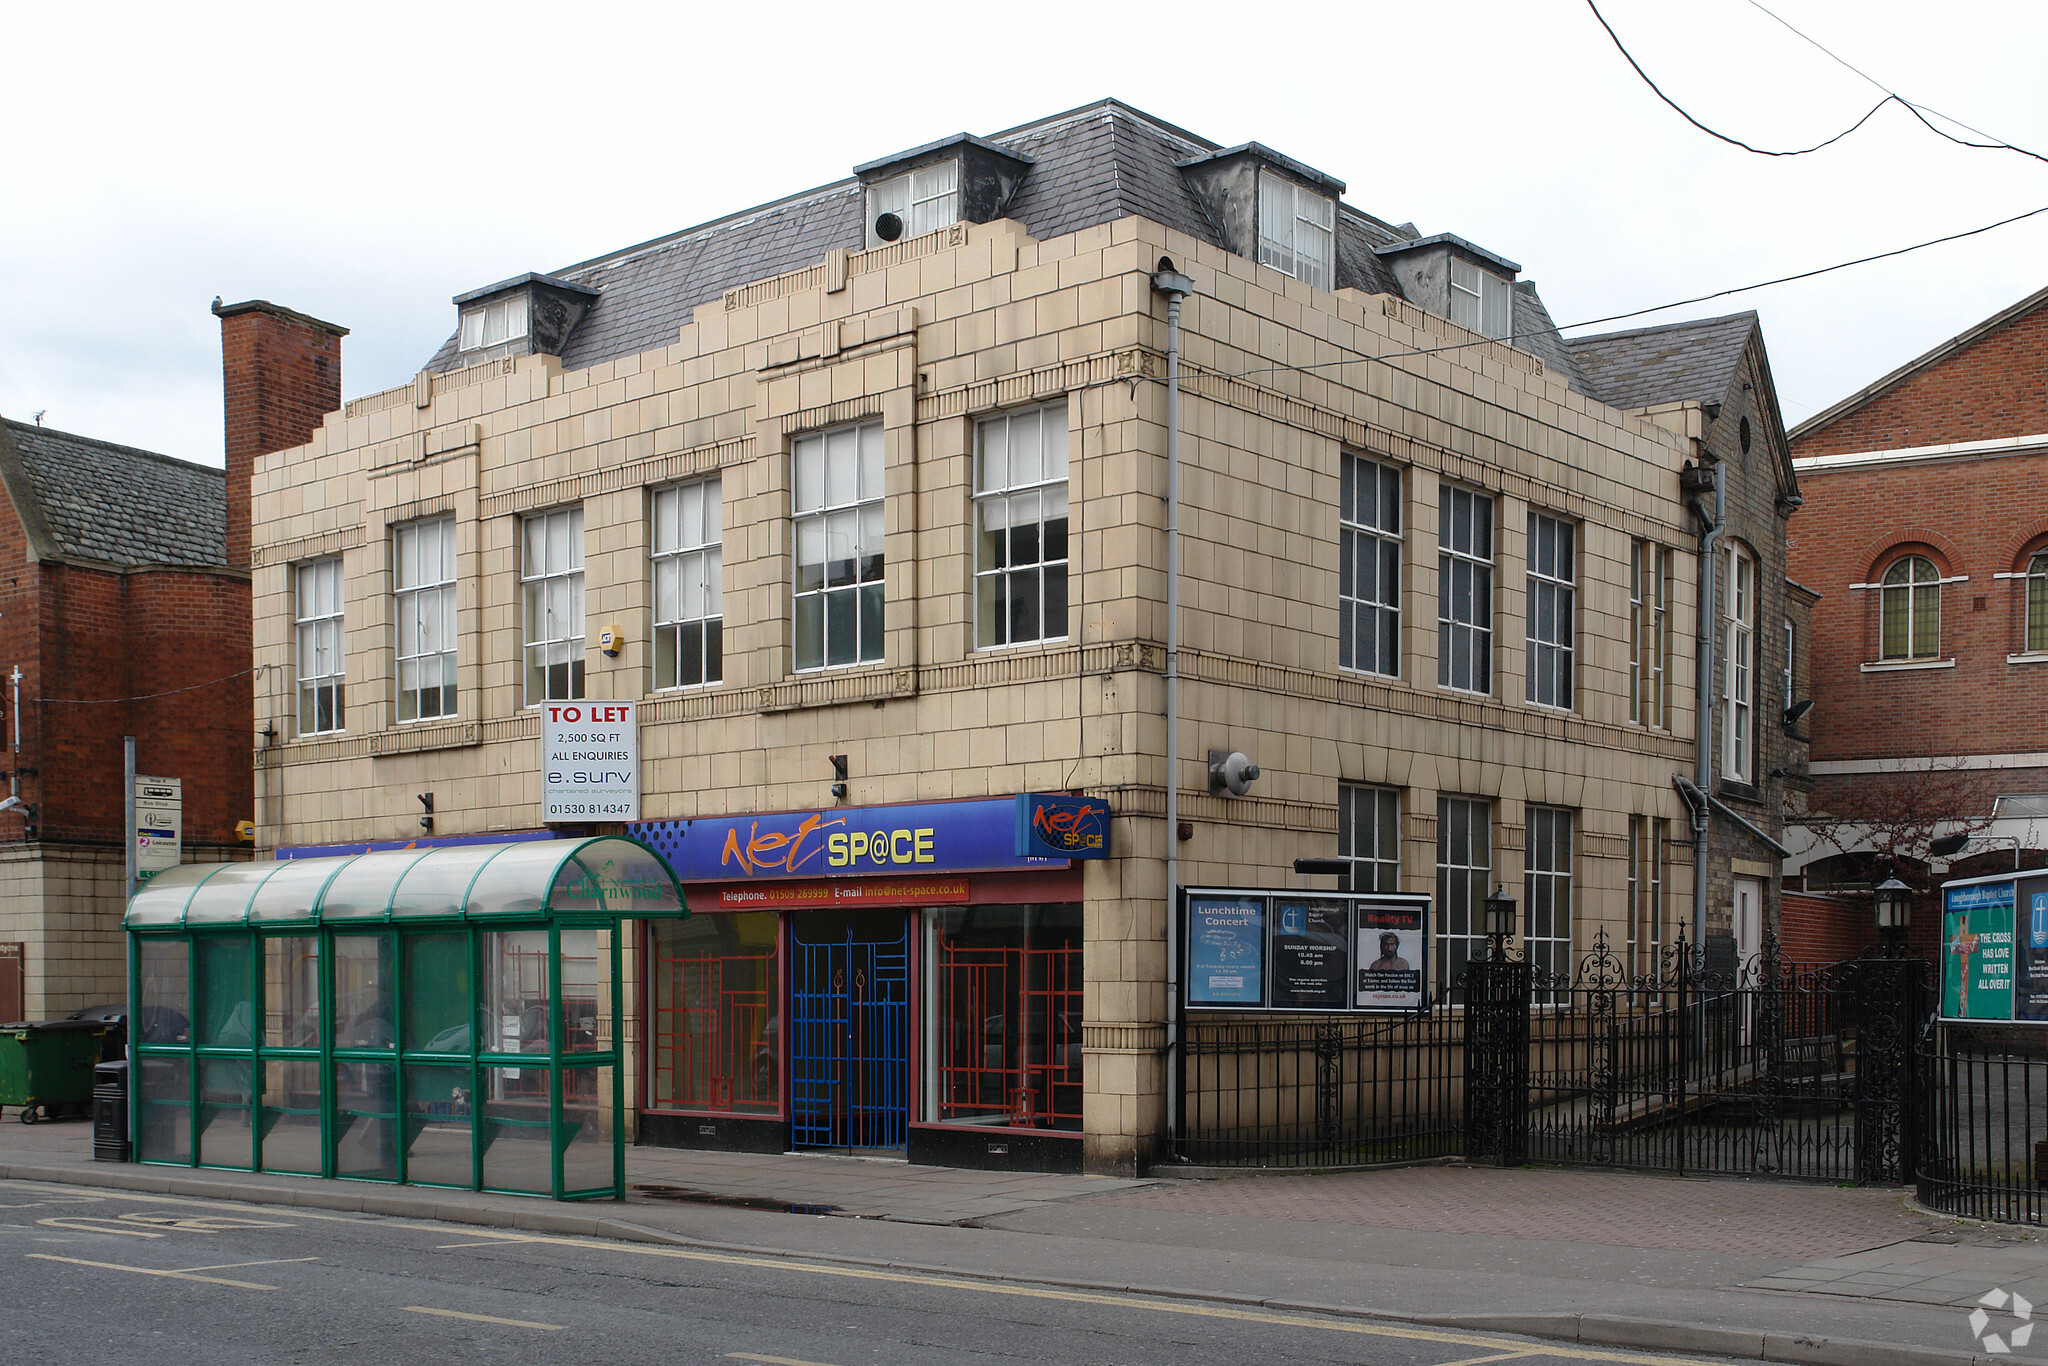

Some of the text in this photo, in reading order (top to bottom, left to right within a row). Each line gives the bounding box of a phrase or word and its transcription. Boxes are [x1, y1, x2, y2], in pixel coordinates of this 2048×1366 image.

[548, 706, 629, 722] TO LET
[557, 733, 620, 744] 2,500 SQ FT
[551, 751, 629, 761] ALL ENQUIRIES
[548, 771, 631, 783] e.surv
[550, 804, 630, 814] 01530 814347
[1033, 803, 1104, 848] Net SP@CE
[141, 837, 148, 846] 2
[721, 814, 935, 876] Net SP@CE
[566, 880, 661, 899] Charnwood
[722, 883, 965, 903] Telephone. 01509 269999 E-mail info@net-space.co.uk
[1982, 889, 1998, 900] Baptist
[1998, 887, 2015, 898] Church
[1198, 906, 1256, 916] Lunchtime
[1205, 917, 1249, 926] Concert
[1368, 914, 1414, 925] Reality TV
[1980, 932, 2011, 943] THE CROSS
[1982, 948, 2010, 959] HAS LOVE
[1982, 963, 2009, 974] WRITTEN
[1978, 979, 2011, 990] ALL OVER IT
